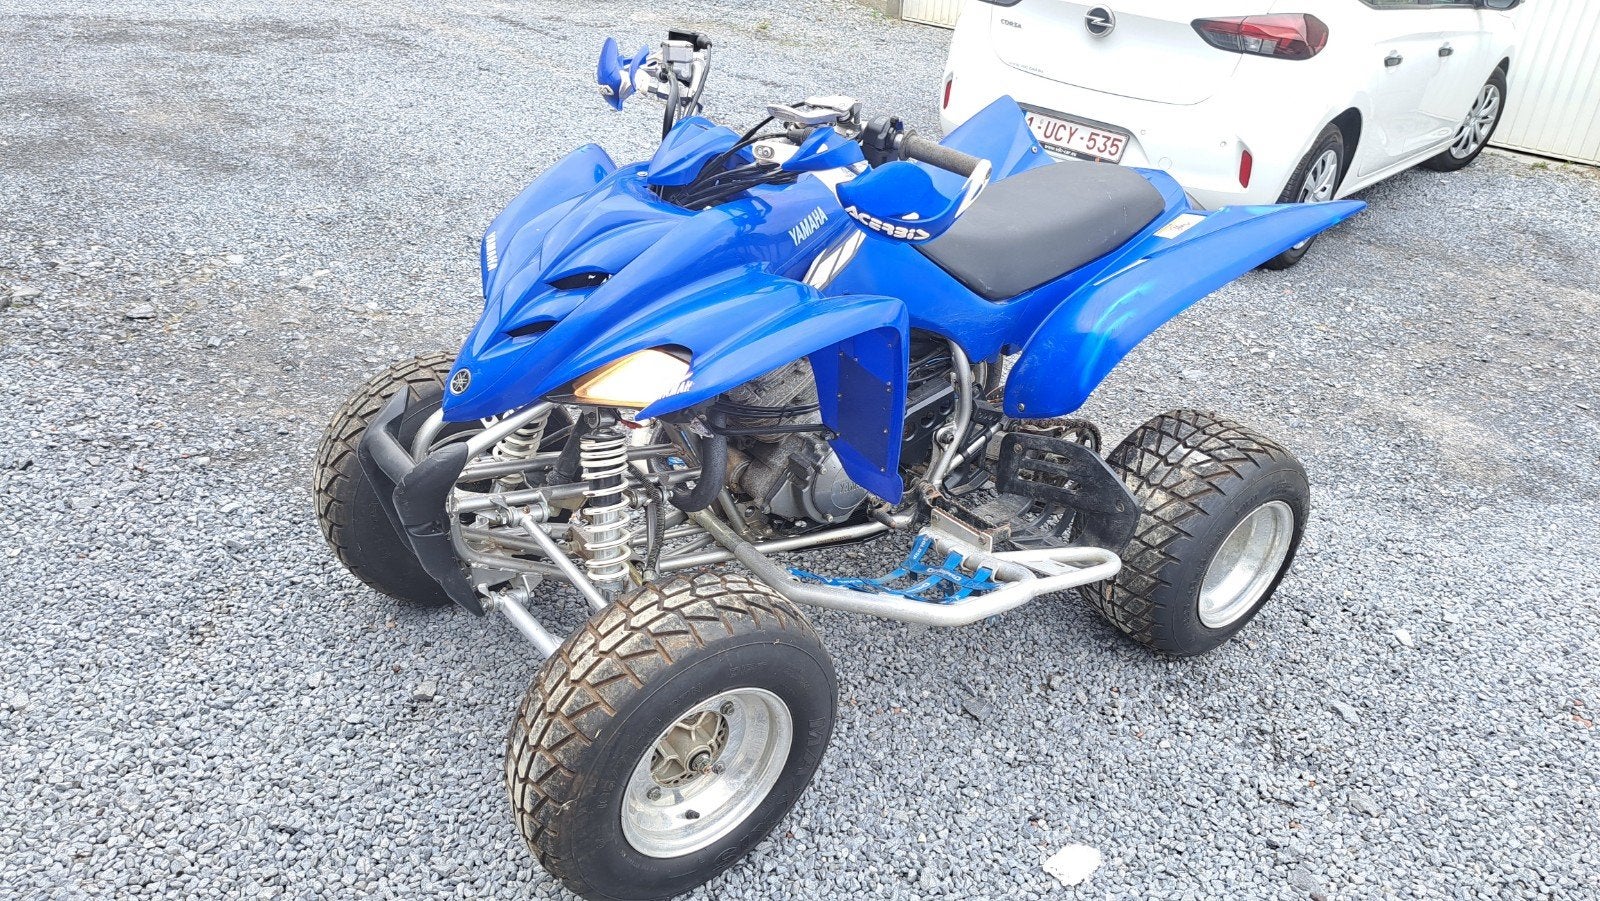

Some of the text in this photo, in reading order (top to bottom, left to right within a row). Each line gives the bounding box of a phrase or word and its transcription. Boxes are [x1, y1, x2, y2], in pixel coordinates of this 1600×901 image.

[1000, 18, 1022, 29] CORSA
[788, 205, 829, 246] YAMAHA
[844, 205, 931, 241] ACERBIS
